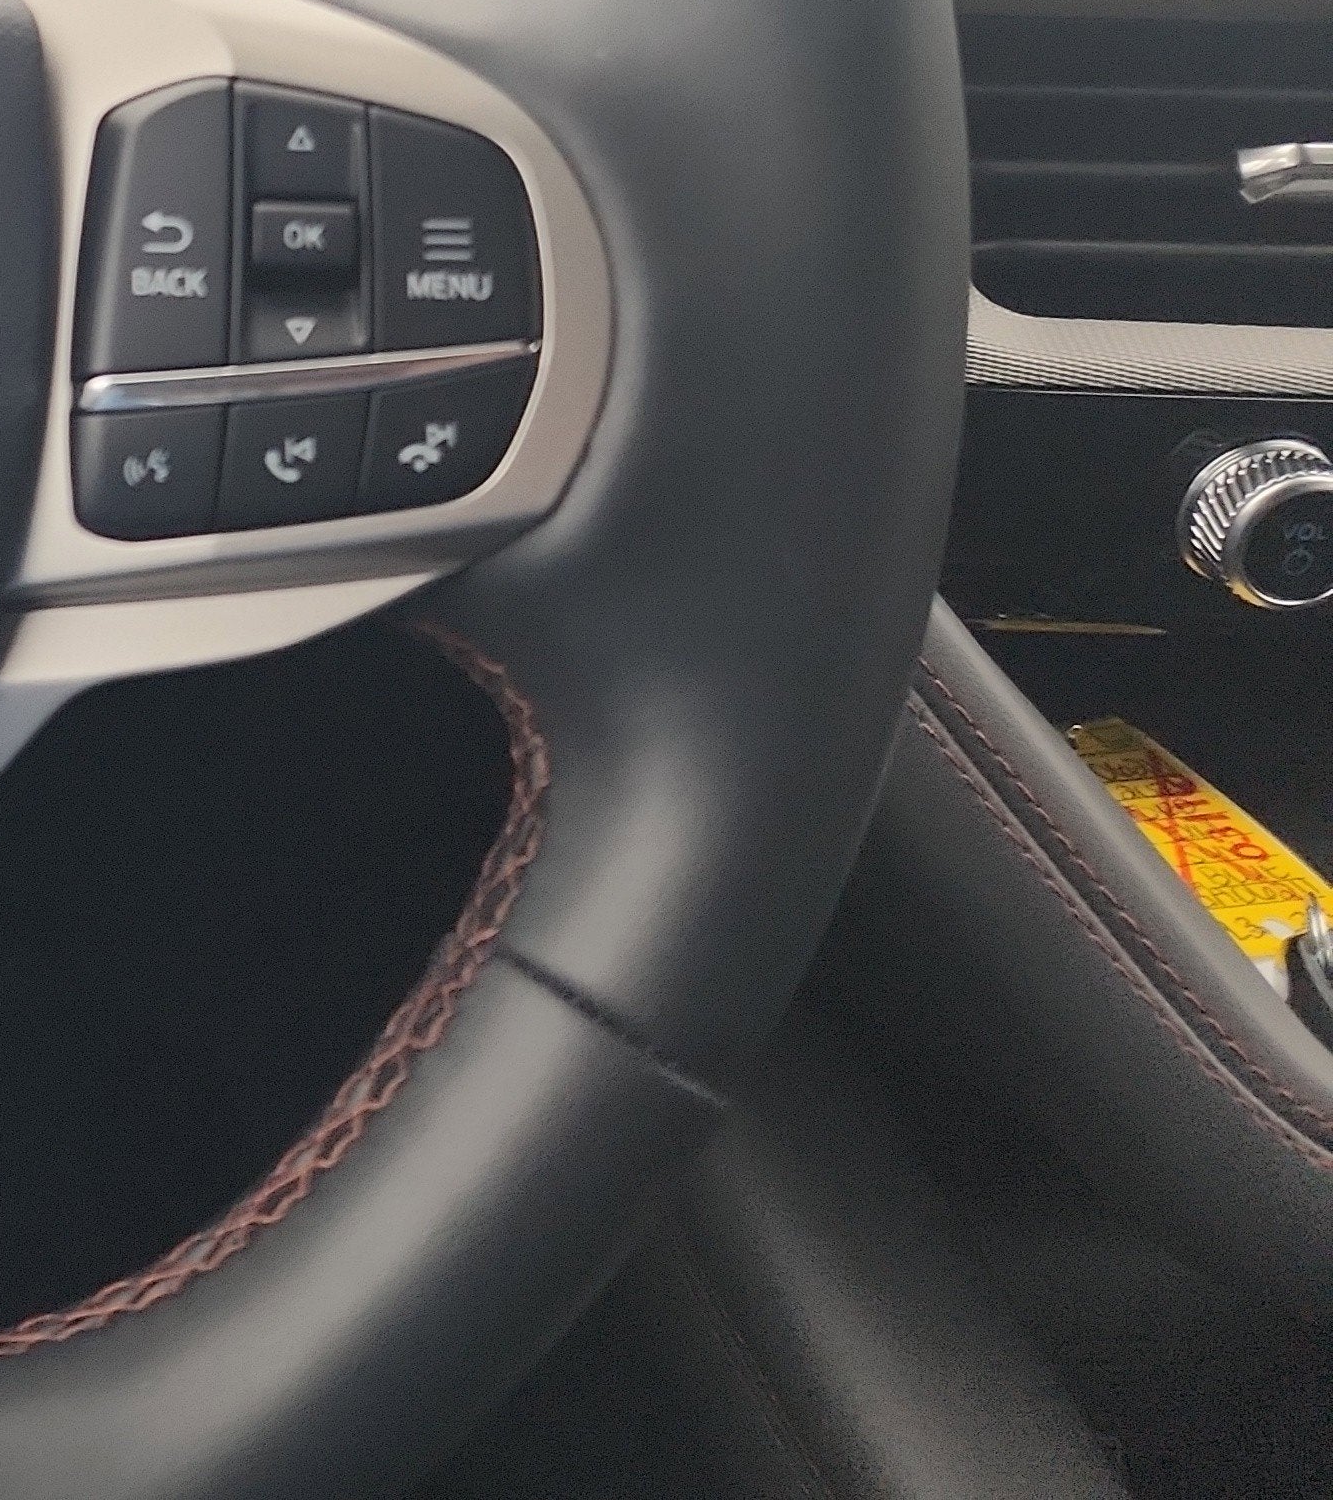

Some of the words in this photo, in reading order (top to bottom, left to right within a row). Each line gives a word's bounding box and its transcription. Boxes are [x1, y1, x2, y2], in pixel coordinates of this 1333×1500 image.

[282, 222, 326, 250] OK
[131, 268, 209, 299] BACK
[405, 272, 493, 301] MENU
